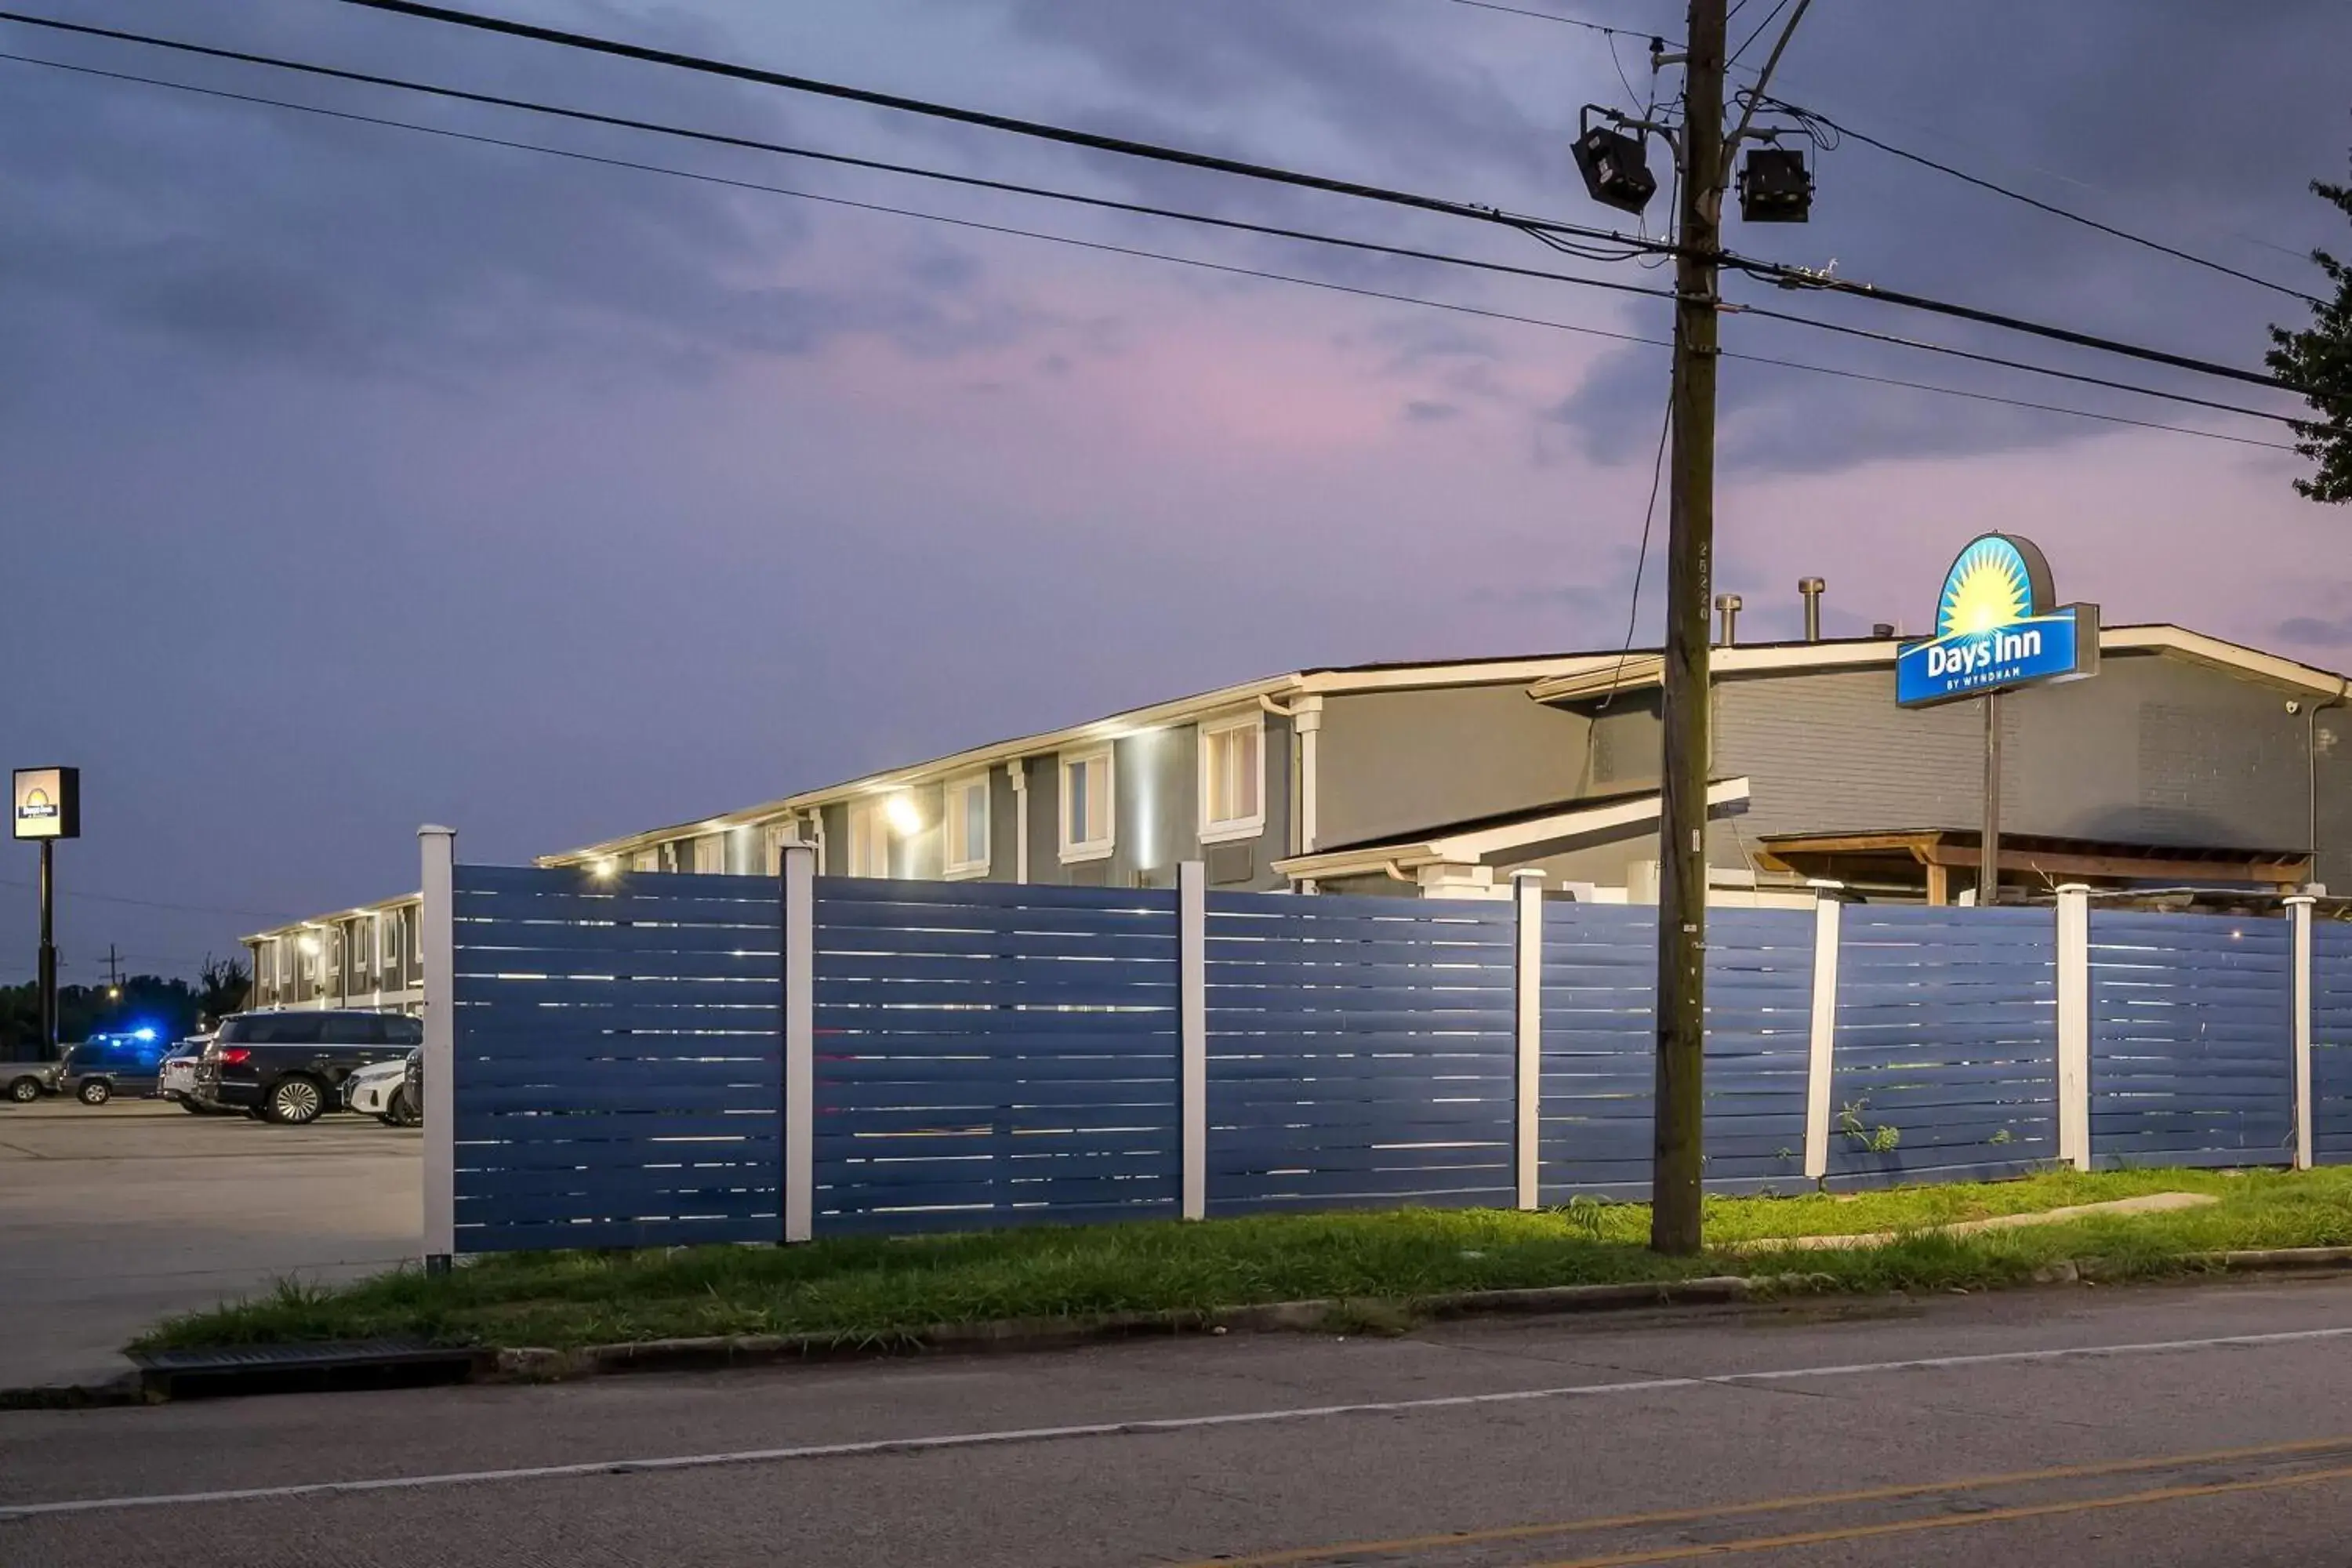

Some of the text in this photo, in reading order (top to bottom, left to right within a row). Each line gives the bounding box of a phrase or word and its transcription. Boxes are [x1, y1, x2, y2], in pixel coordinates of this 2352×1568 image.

[1929, 630, 2041, 677] Days Inn
[1947, 666, 2020, 690] BY WYNDHAM
